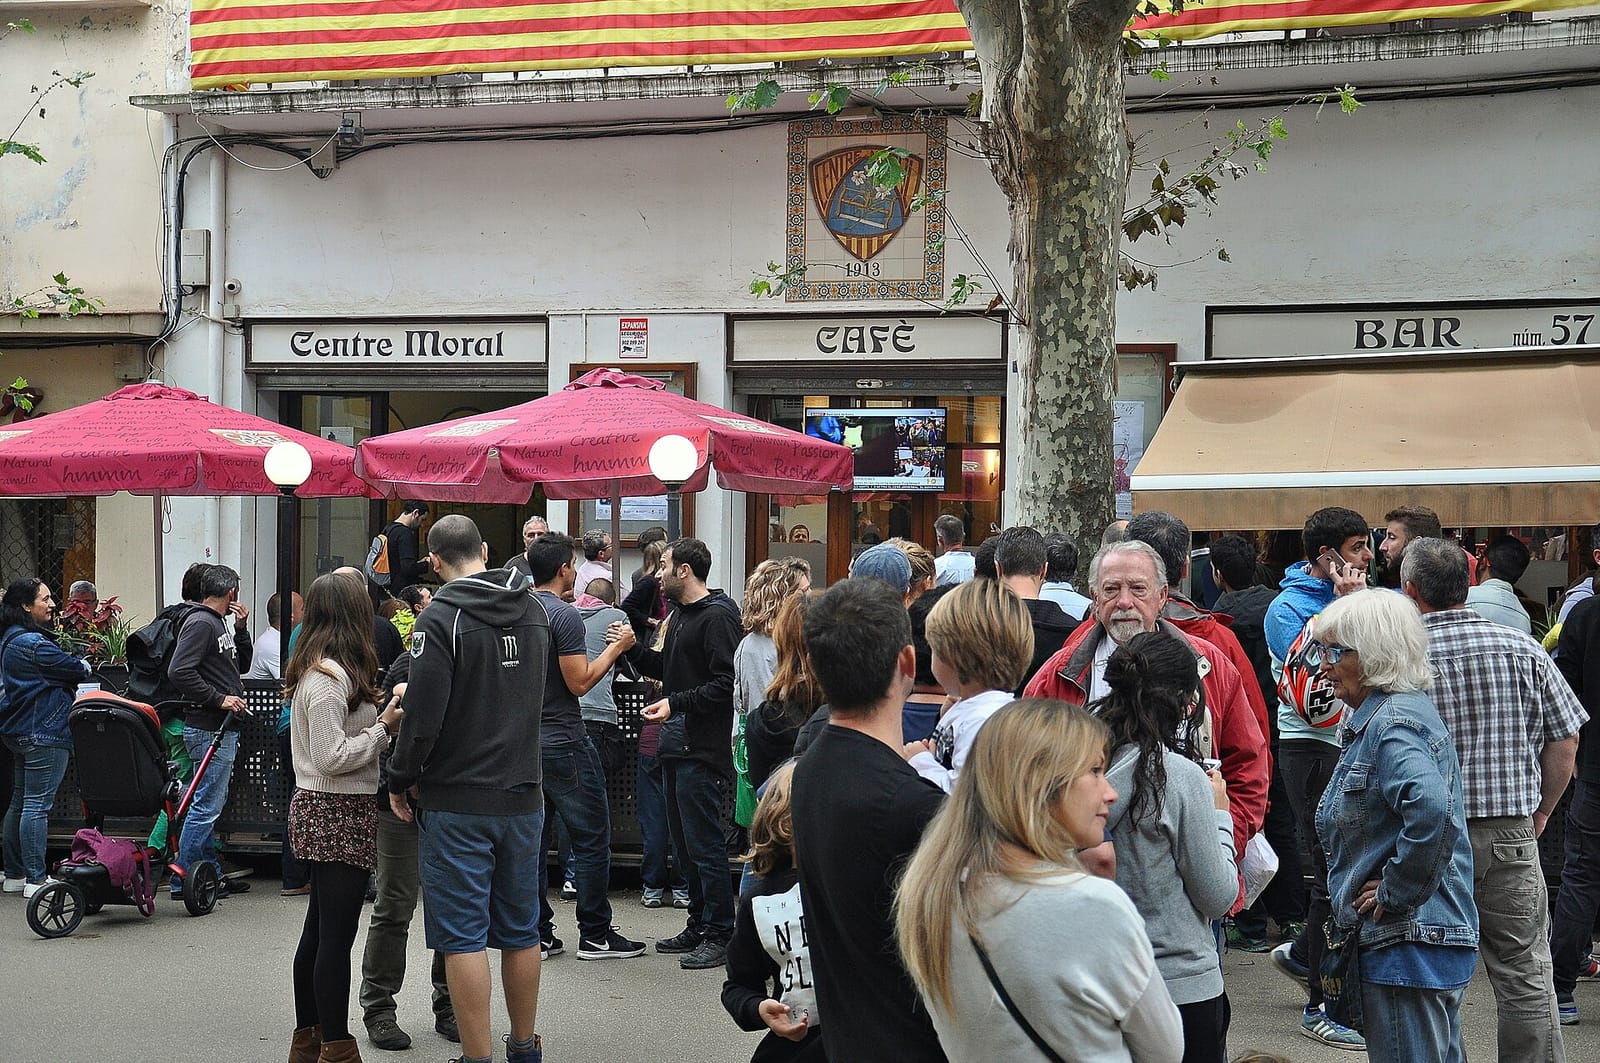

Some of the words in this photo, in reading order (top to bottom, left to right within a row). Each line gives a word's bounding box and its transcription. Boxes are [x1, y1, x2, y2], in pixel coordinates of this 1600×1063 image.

[844, 262, 881, 278] 1913
[815, 319, 916, 354] CAFÈ
[1353, 317, 1462, 350] BAR
[1550, 314, 1596, 346] 57
[290, 331, 393, 357] Centre
[404, 330, 504, 357] Moral
[570, 432, 640, 447] Creative
[513, 445, 563, 461] Natural
[792, 440, 840, 460] Passion
[3, 456, 53, 469] Natural
